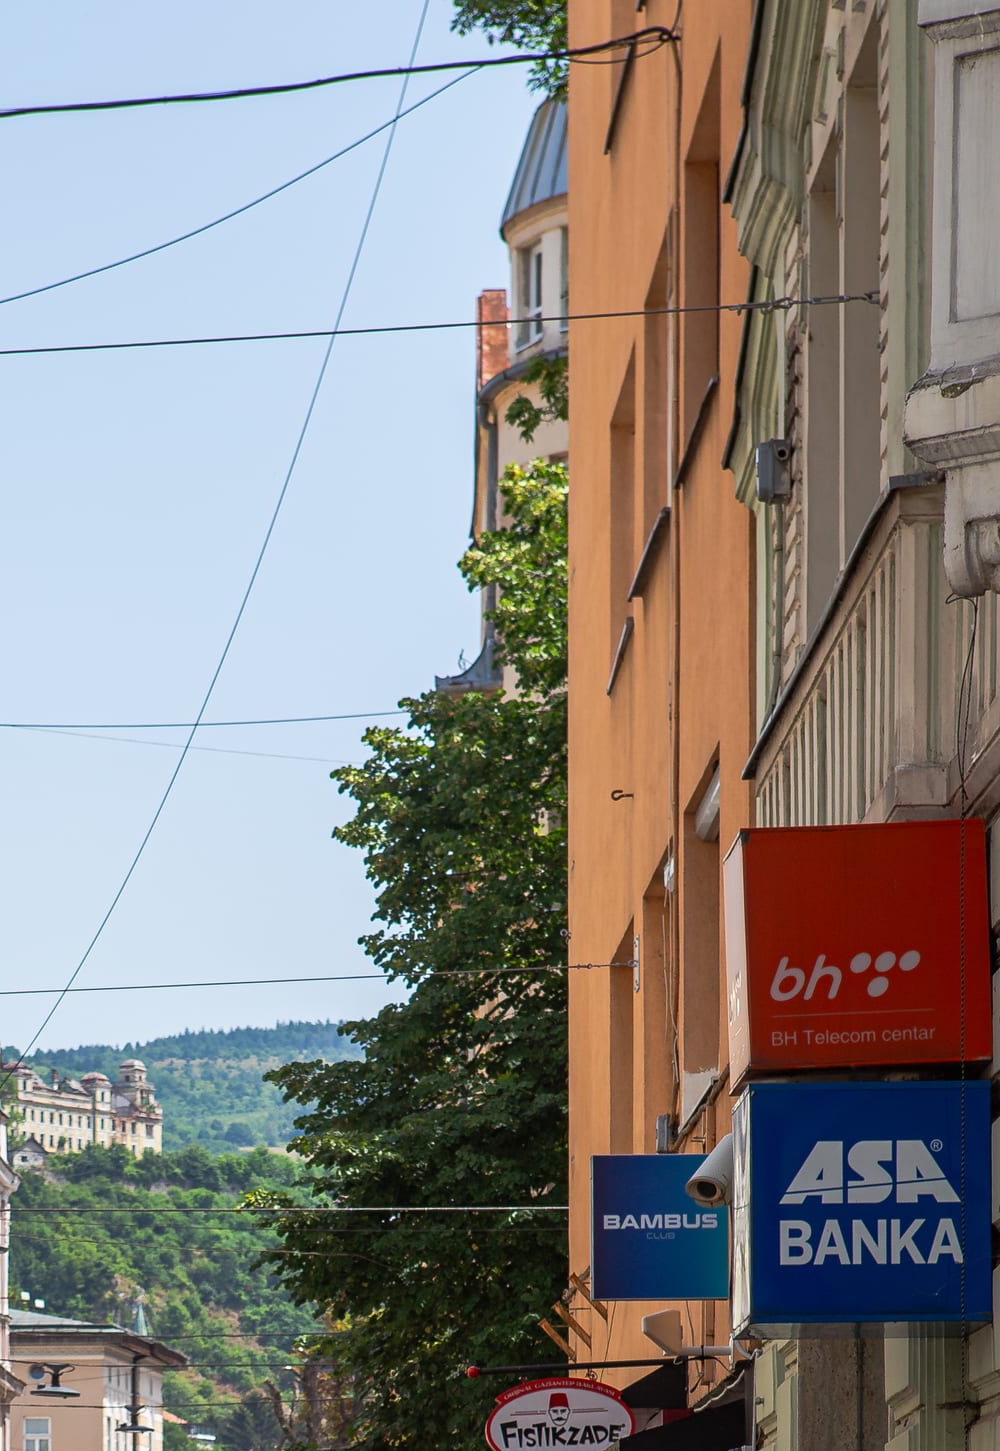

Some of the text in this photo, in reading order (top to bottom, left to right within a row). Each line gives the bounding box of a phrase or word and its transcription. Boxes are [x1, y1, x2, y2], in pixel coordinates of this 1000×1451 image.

[770, 954, 842, 1002] bh
[771, 1027, 935, 1046] BH Telecom centar
[778, 1139, 961, 1205] ASA
[603, 1213, 718, 1230] BAMBUS
[646, 1231, 676, 1240] CLUB
[779, 1217, 964, 1266] BANKA
[500, 1420, 623, 1449] FISTIKZADE
